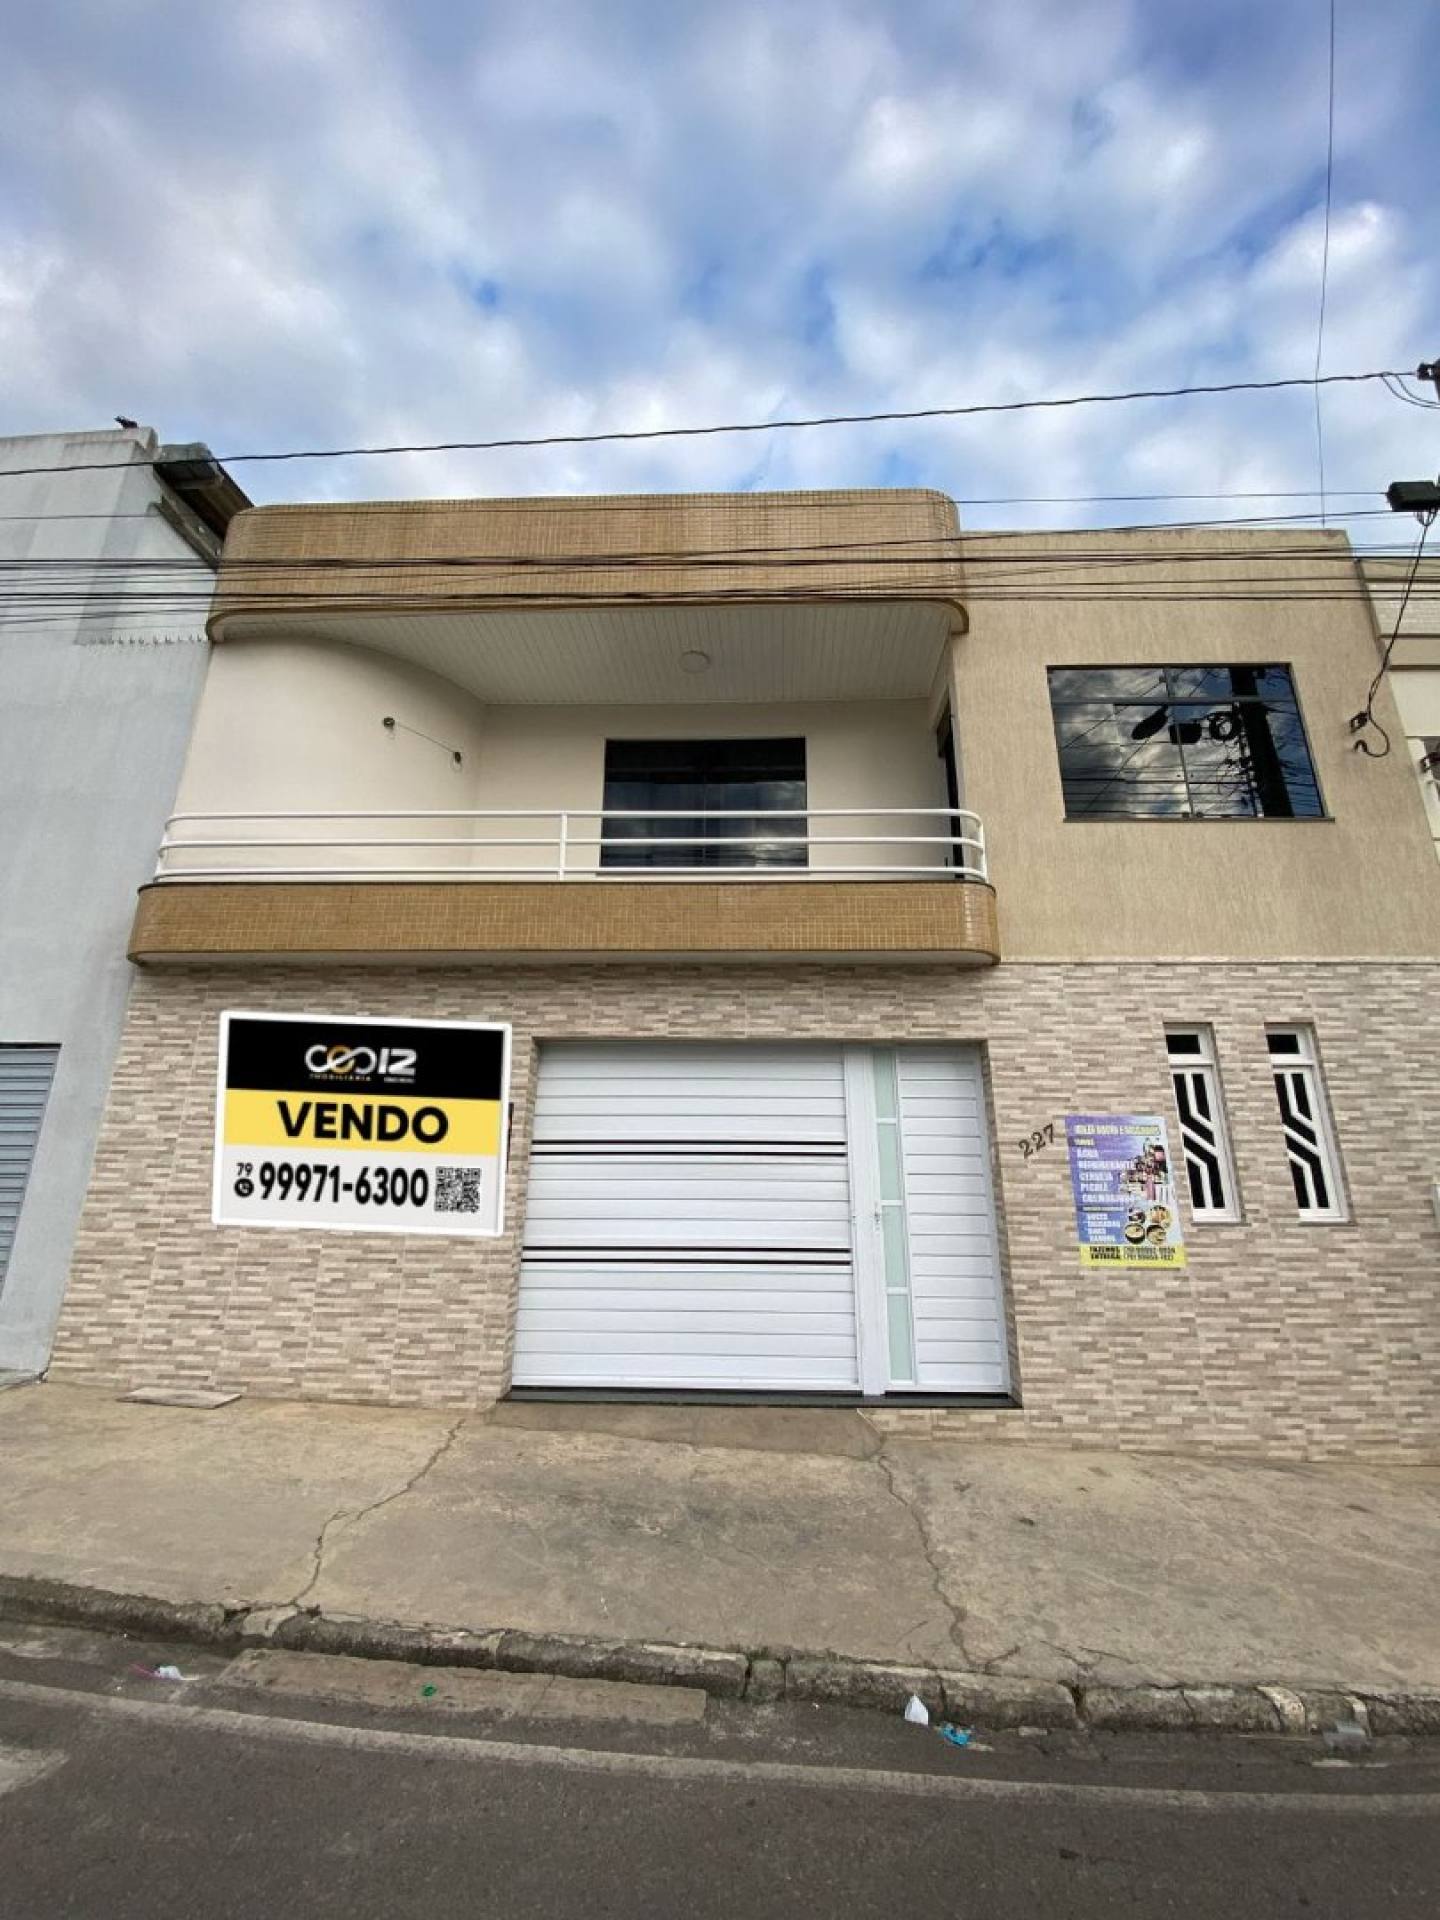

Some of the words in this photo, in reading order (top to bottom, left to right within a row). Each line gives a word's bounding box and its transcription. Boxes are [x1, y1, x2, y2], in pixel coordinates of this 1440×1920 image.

[276, 1099, 449, 1144] VENDO
[1018, 1123, 1054, 1159] 227
[236, 1162, 254, 1177] 79
[259, 1161, 429, 1208] 99971-6300
